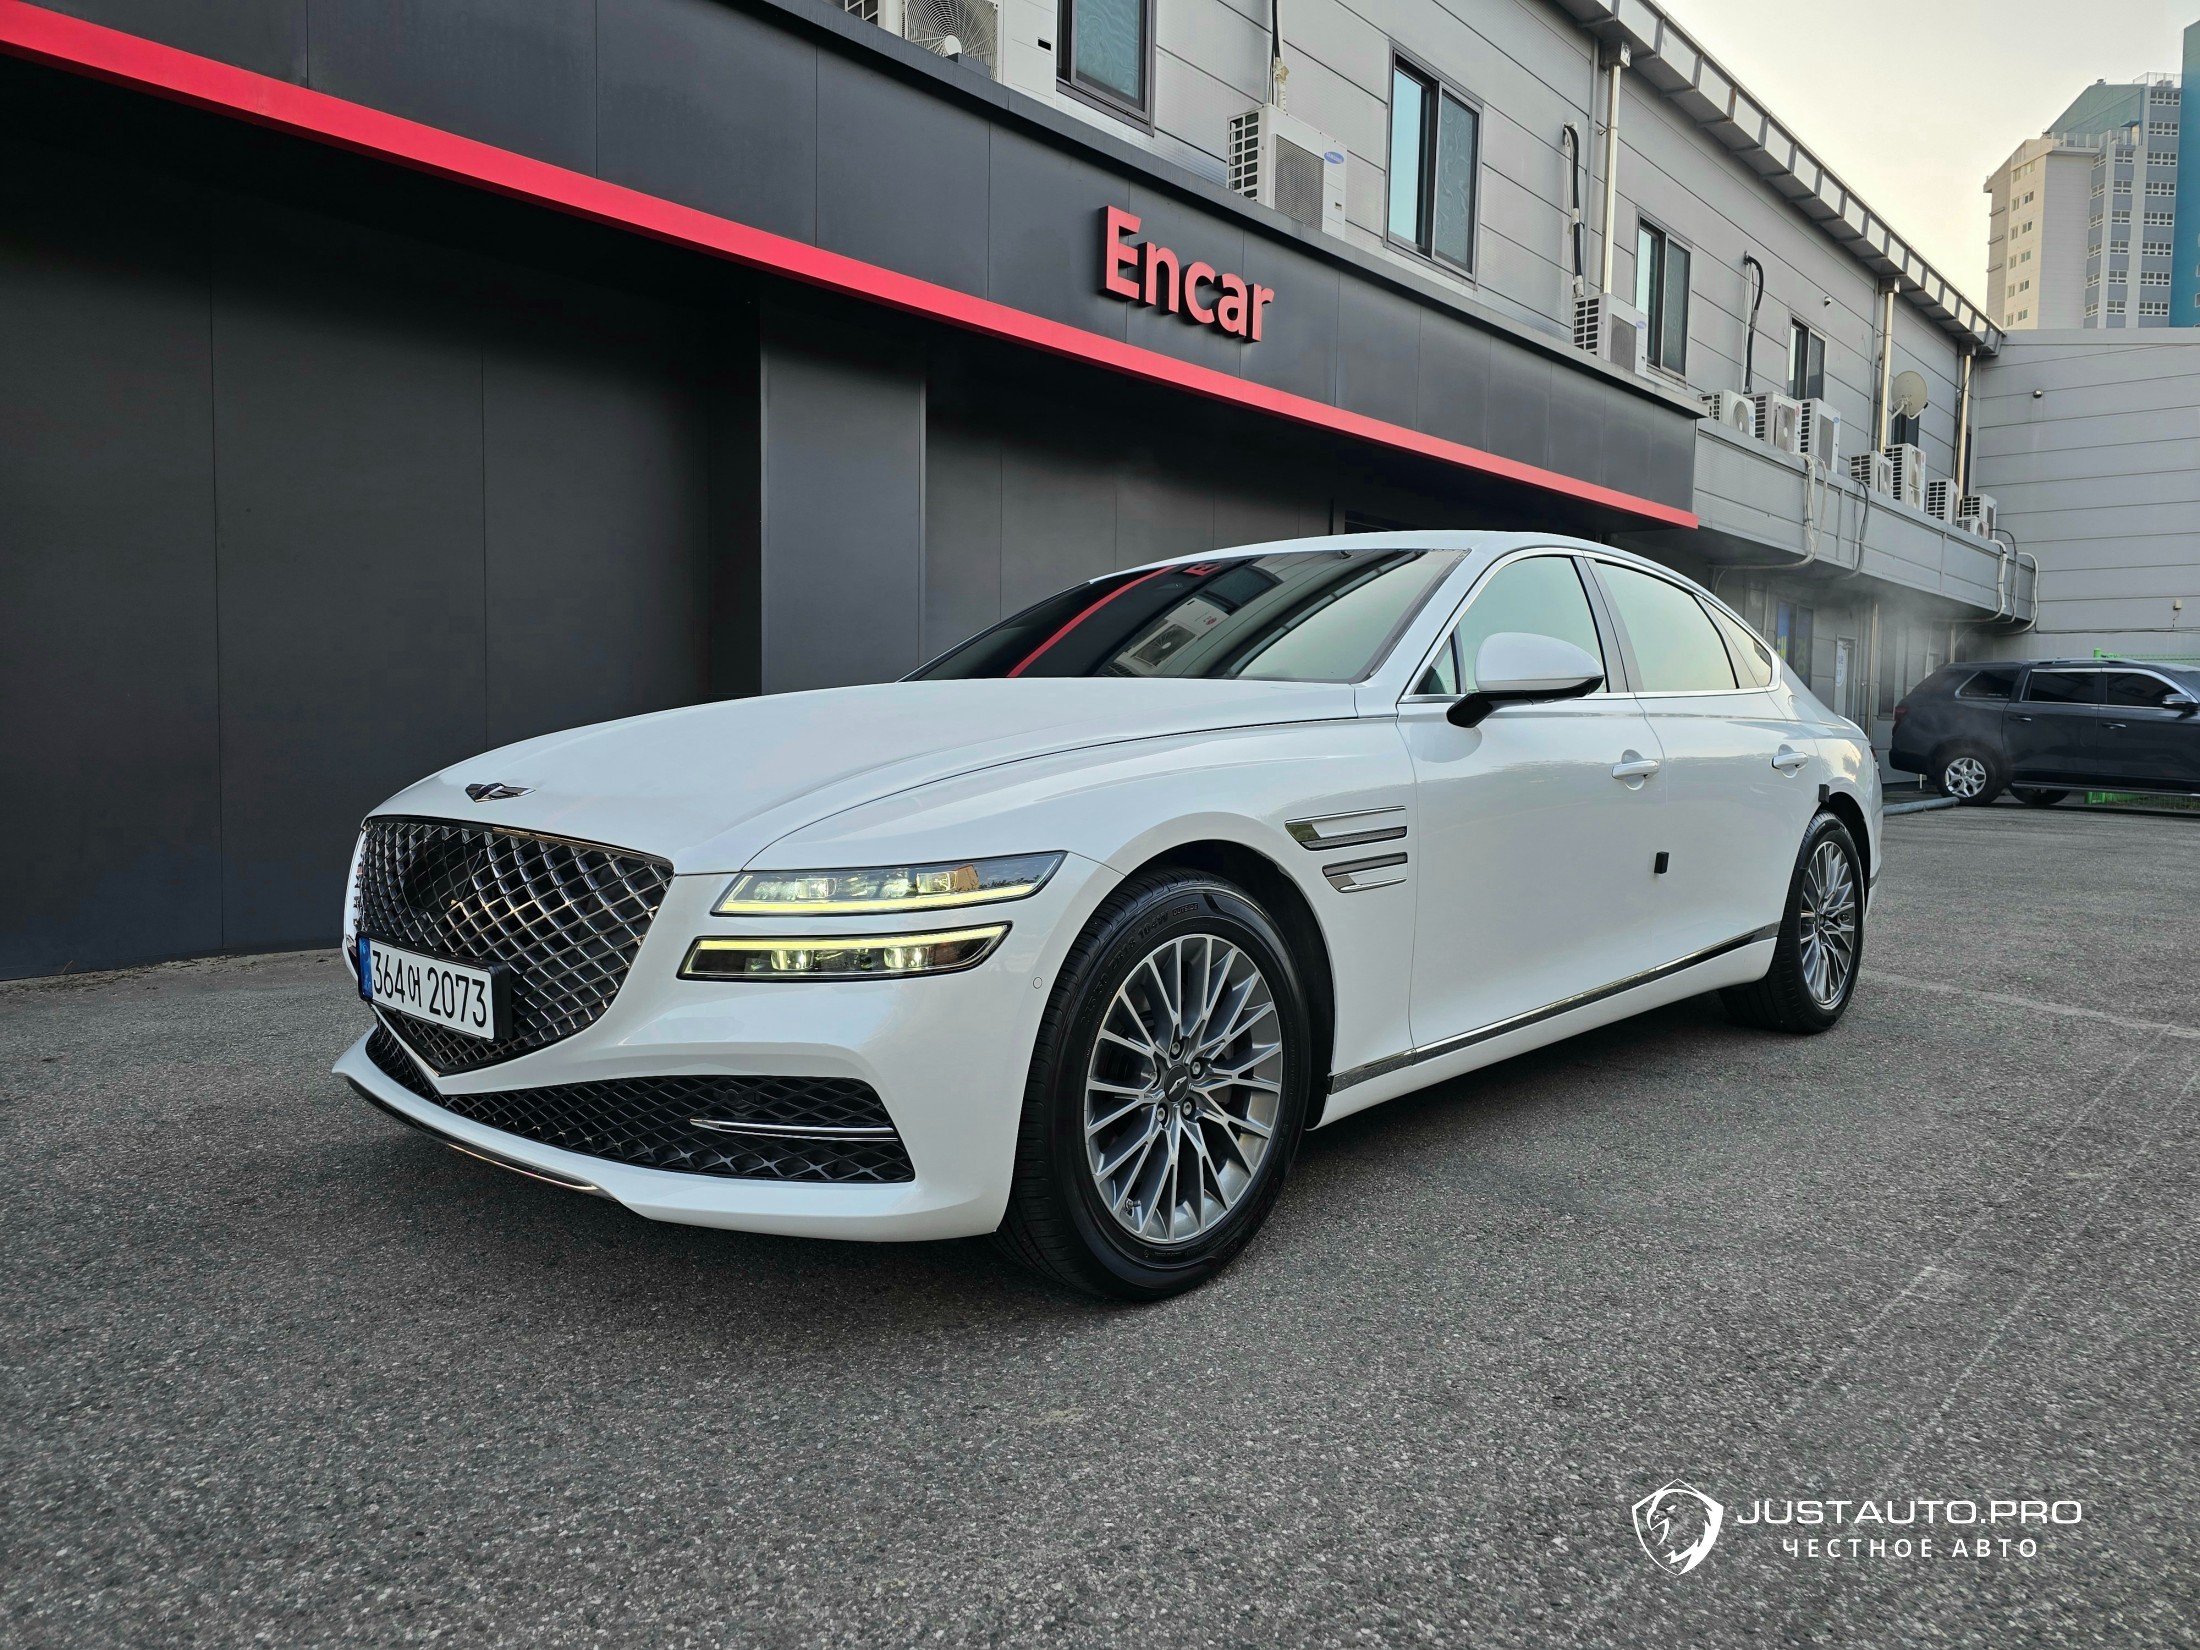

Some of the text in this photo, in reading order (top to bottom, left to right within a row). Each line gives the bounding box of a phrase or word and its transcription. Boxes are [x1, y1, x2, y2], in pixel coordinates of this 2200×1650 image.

[1104, 204, 1275, 343] Encar
[1173, 903, 1198, 916] OUTSIDE
[372, 950, 487, 1028] 364어 2073
